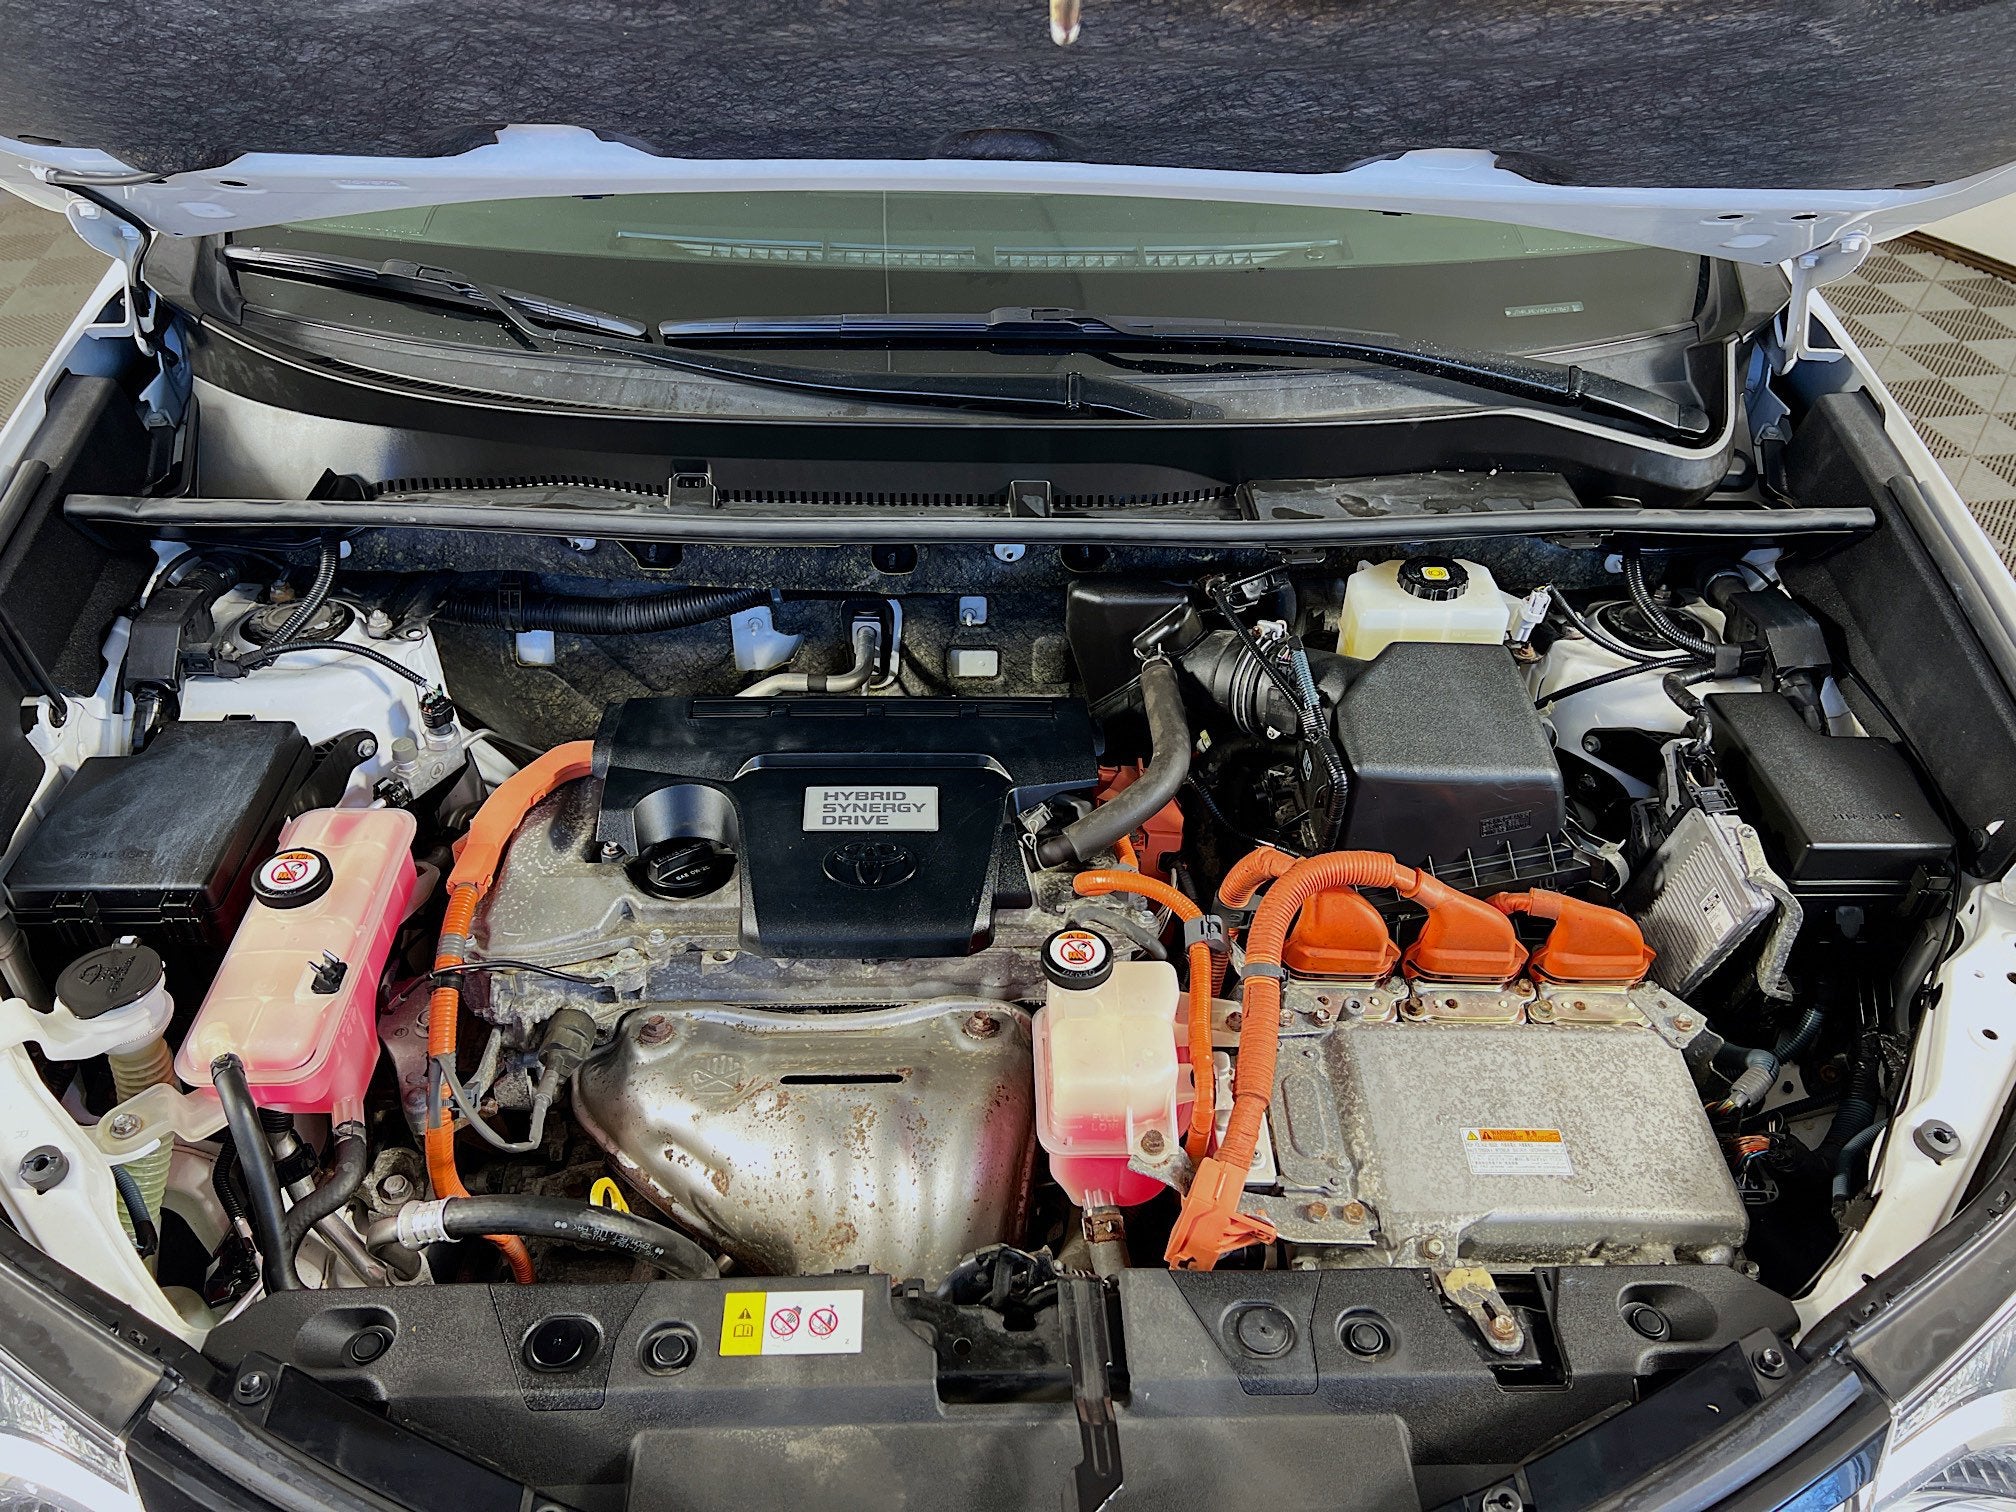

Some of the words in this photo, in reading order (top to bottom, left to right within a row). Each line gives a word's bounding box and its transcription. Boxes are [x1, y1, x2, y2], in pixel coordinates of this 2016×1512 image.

[823, 791, 907, 801] HYBRID
[822, 803, 927, 813] SYNERGY
[822, 815, 889, 825] DRIVE
